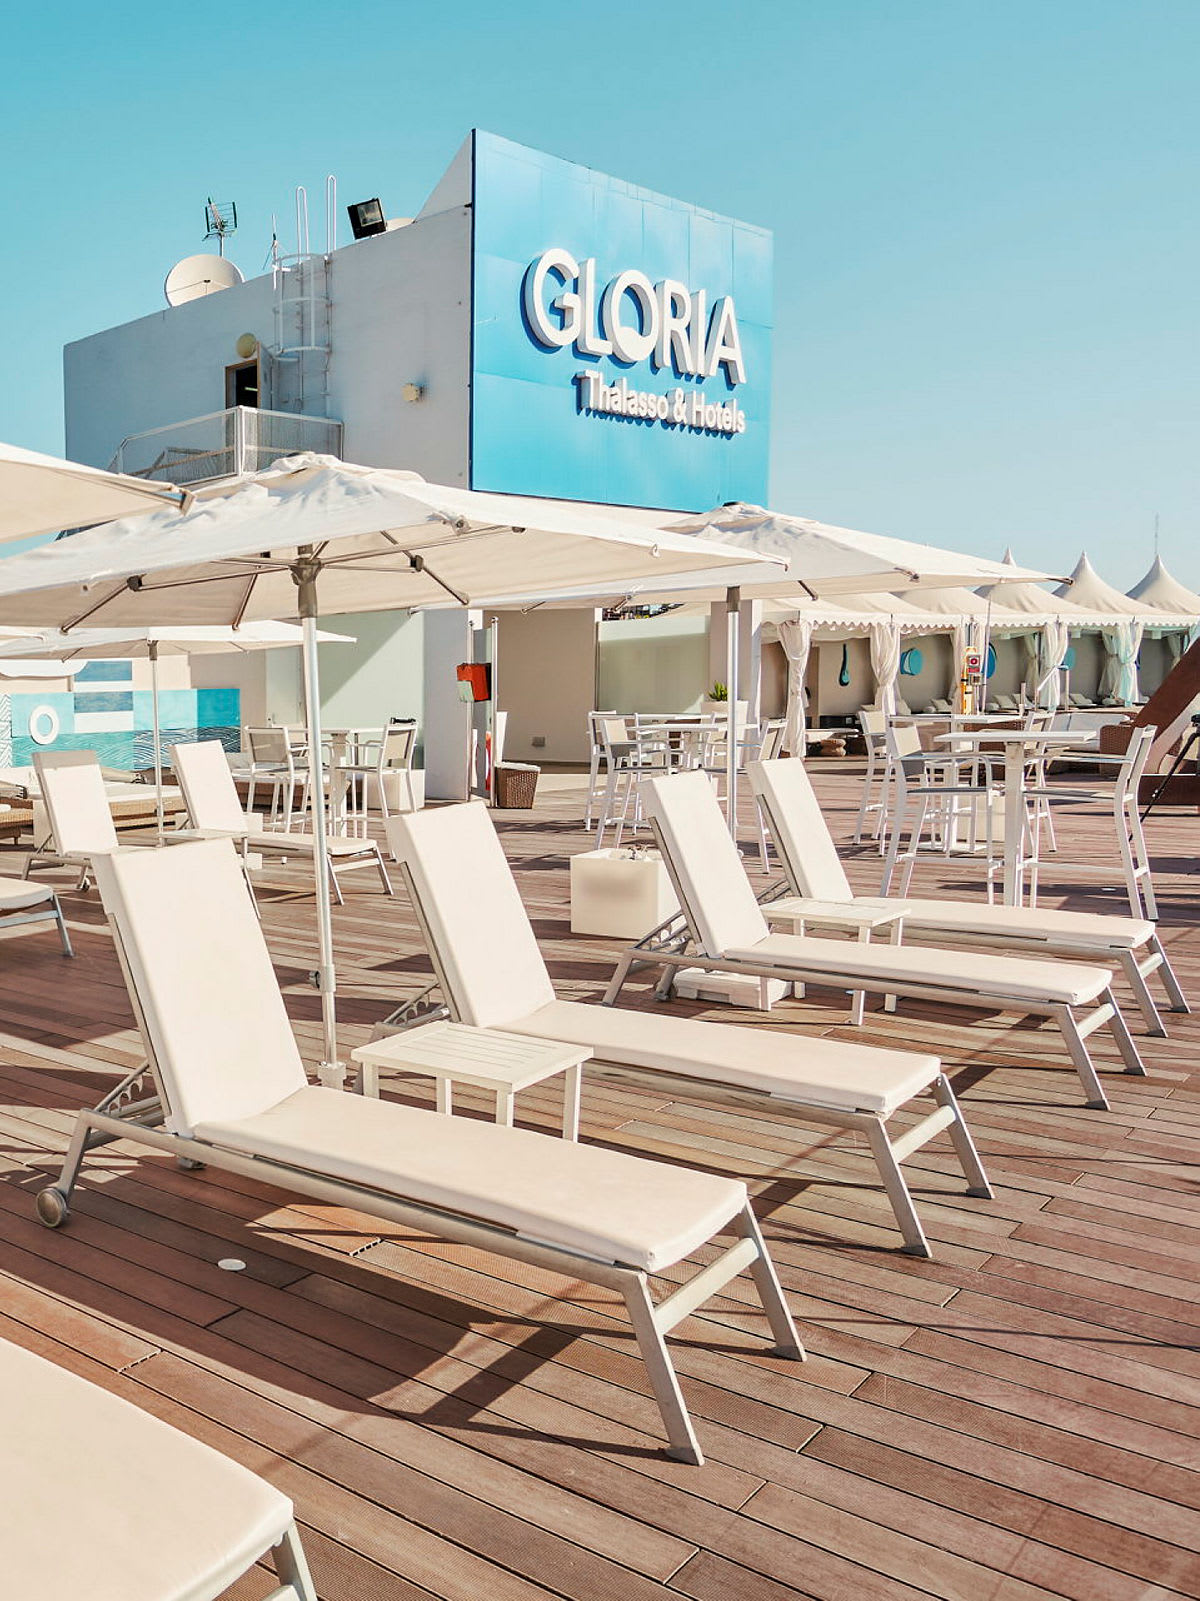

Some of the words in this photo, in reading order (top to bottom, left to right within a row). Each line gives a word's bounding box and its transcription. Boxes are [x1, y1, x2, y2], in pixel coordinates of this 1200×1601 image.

[527, 248, 746, 384] GLORIA
[581, 369, 668, 420] Thalasso
[670, 388, 686, 423] &
[690, 391, 746, 433] Hotels
